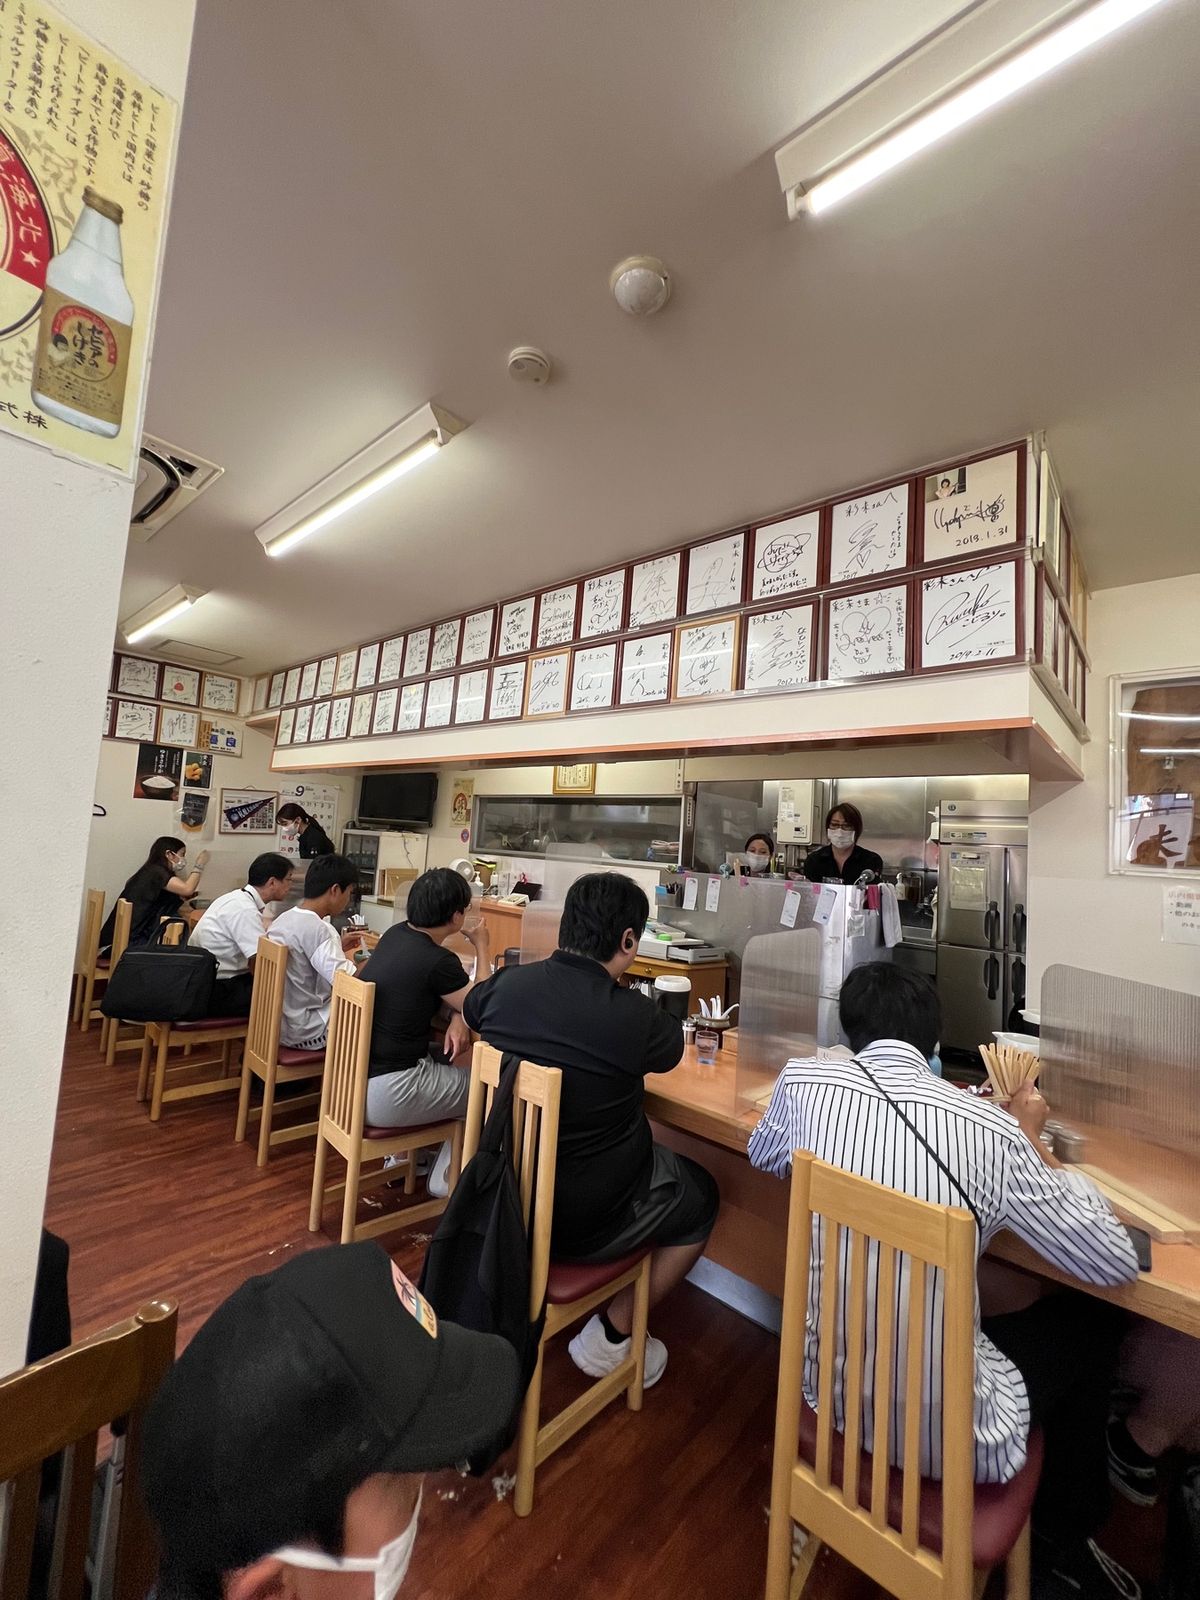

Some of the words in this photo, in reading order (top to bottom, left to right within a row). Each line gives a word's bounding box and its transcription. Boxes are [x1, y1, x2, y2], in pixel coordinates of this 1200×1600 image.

[108, 76, 127, 141] 北海道だけで
[295, 785, 305, 797] 9
